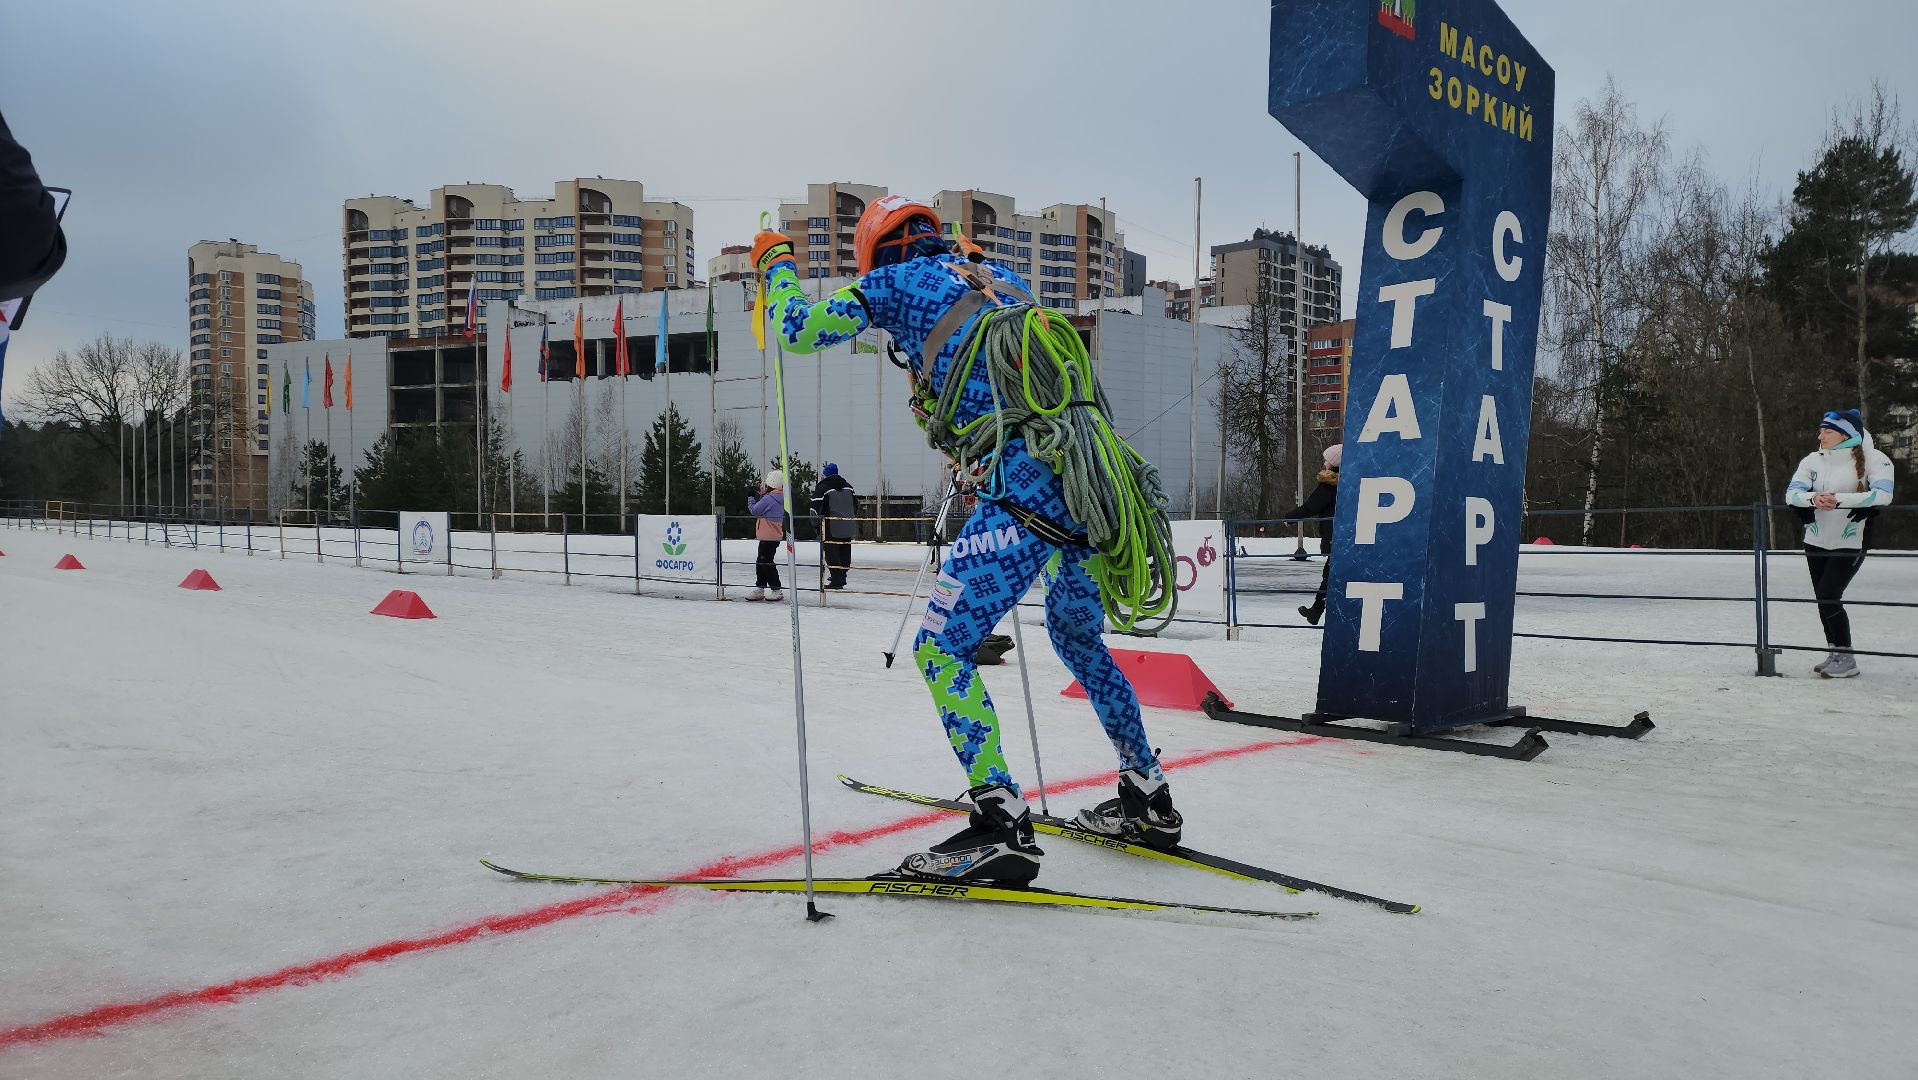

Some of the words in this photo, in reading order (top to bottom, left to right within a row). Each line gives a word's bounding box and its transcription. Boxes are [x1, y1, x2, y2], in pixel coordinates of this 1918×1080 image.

[1440, 21, 1527, 92] МАСОУ
[1428, 67, 1533, 142] ЗОРКИЙ
[1346, 190, 1445, 652] СТАРТ
[1454, 210, 1524, 673] СТАРТ
[656, 558, 693, 571] ФОСАГРО
[1060, 830, 1128, 853] FISCHER
[869, 882, 969, 897] FISCHER
